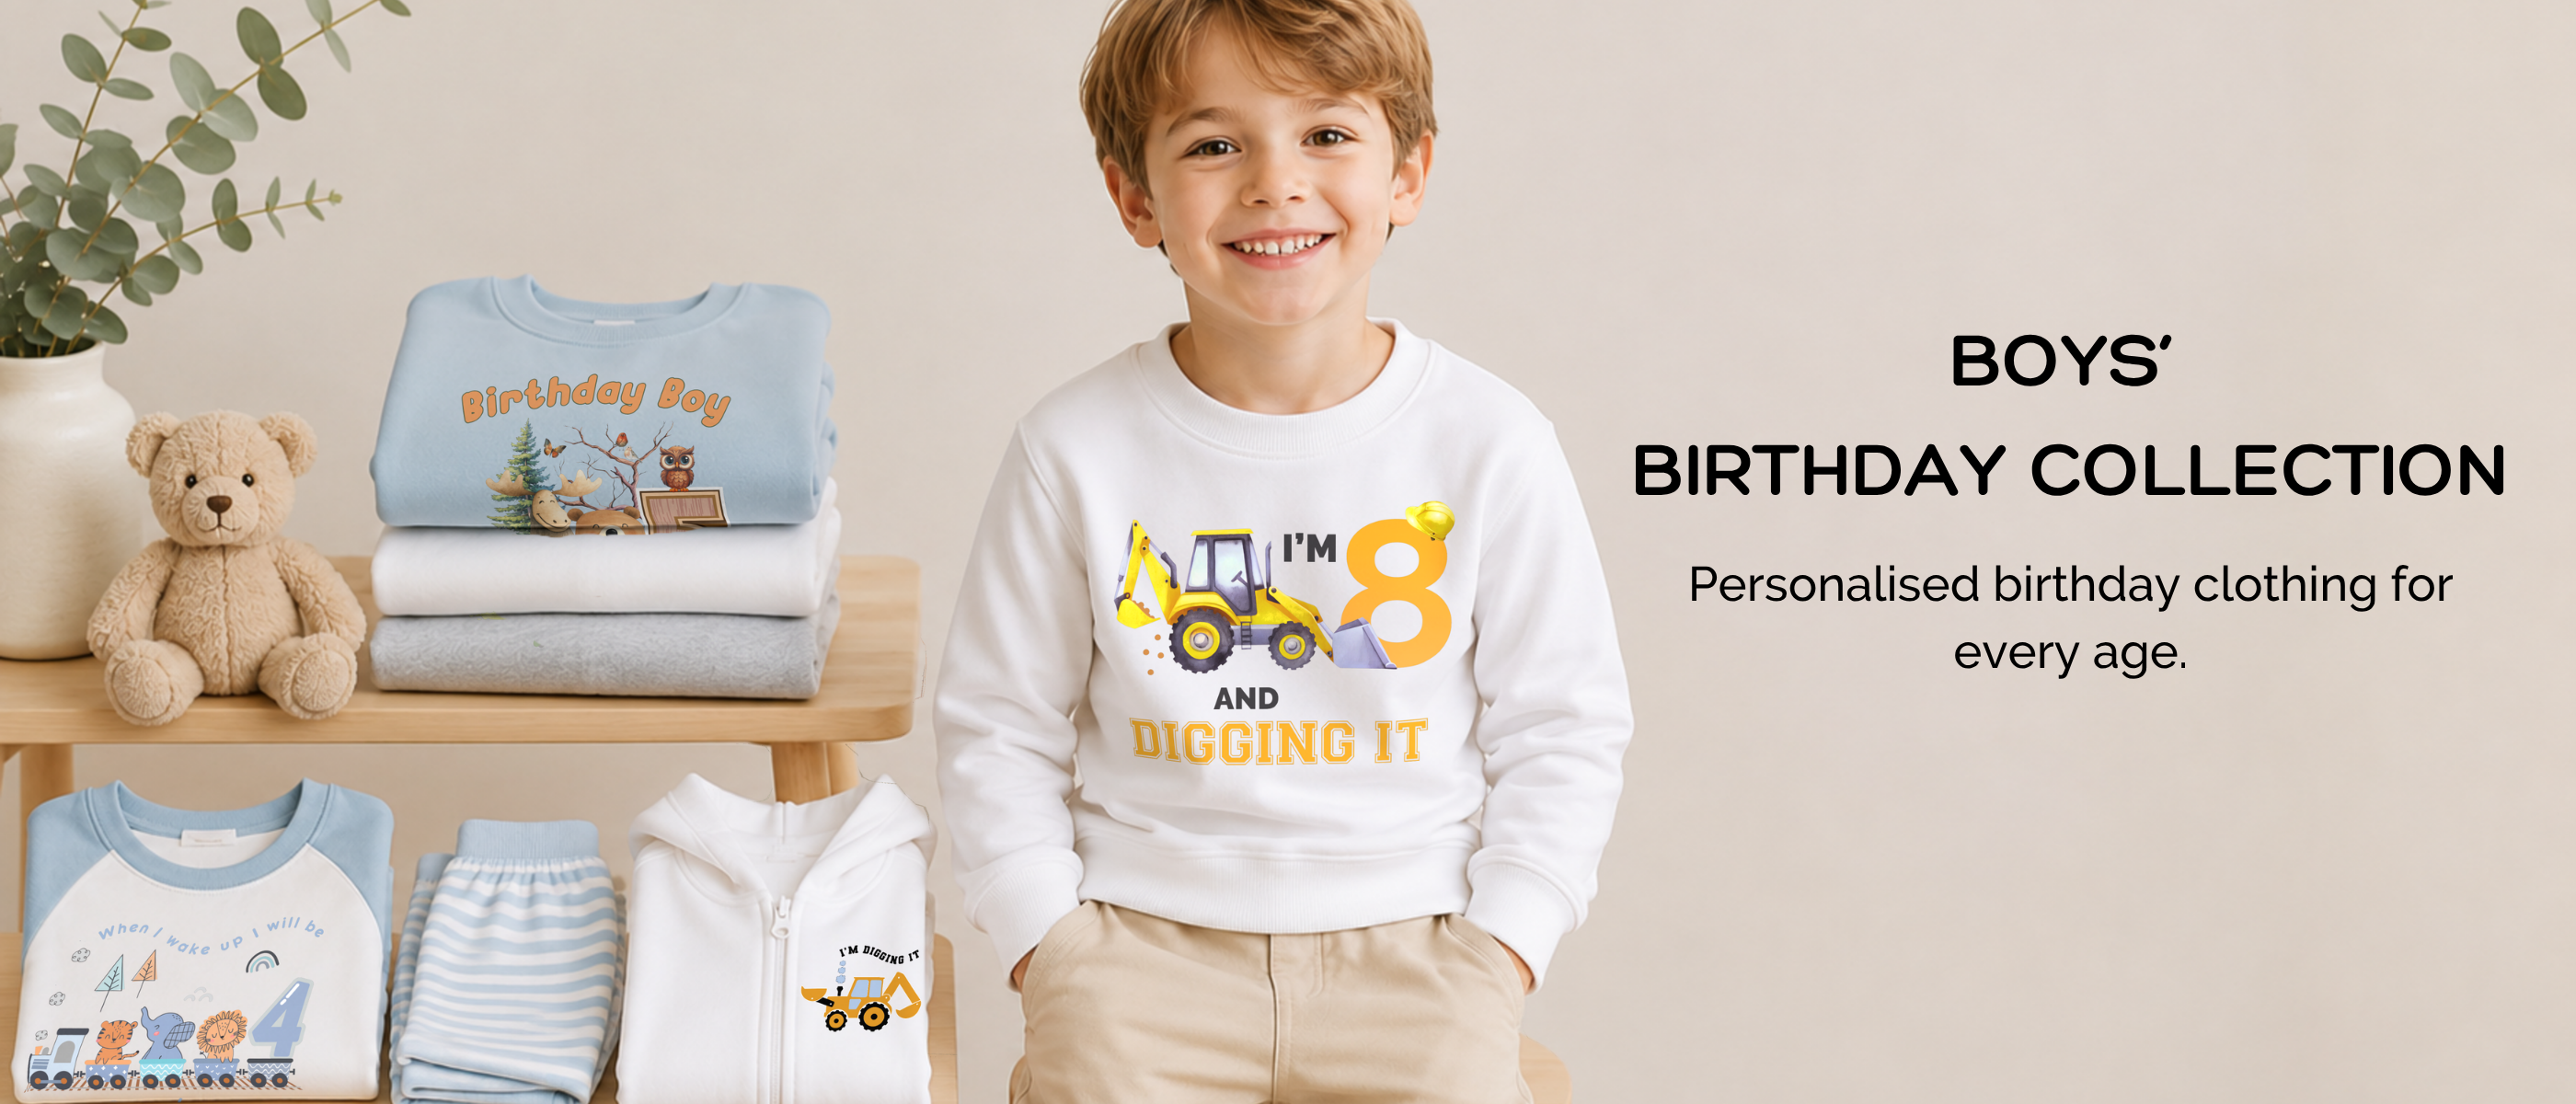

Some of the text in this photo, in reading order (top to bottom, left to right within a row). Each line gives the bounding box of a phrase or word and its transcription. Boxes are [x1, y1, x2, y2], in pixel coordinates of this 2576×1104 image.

[461, 374, 731, 428] Birthday Boy
[1283, 518, 1453, 668] I'M 8
[1213, 686, 1280, 710] AND
[1129, 717, 1429, 765] DIGGING IT
[98, 916, 326, 956] When I wake up I will be
[839, 945, 920, 965] I'M DIGGING IT
[248, 978, 315, 1058] 4
